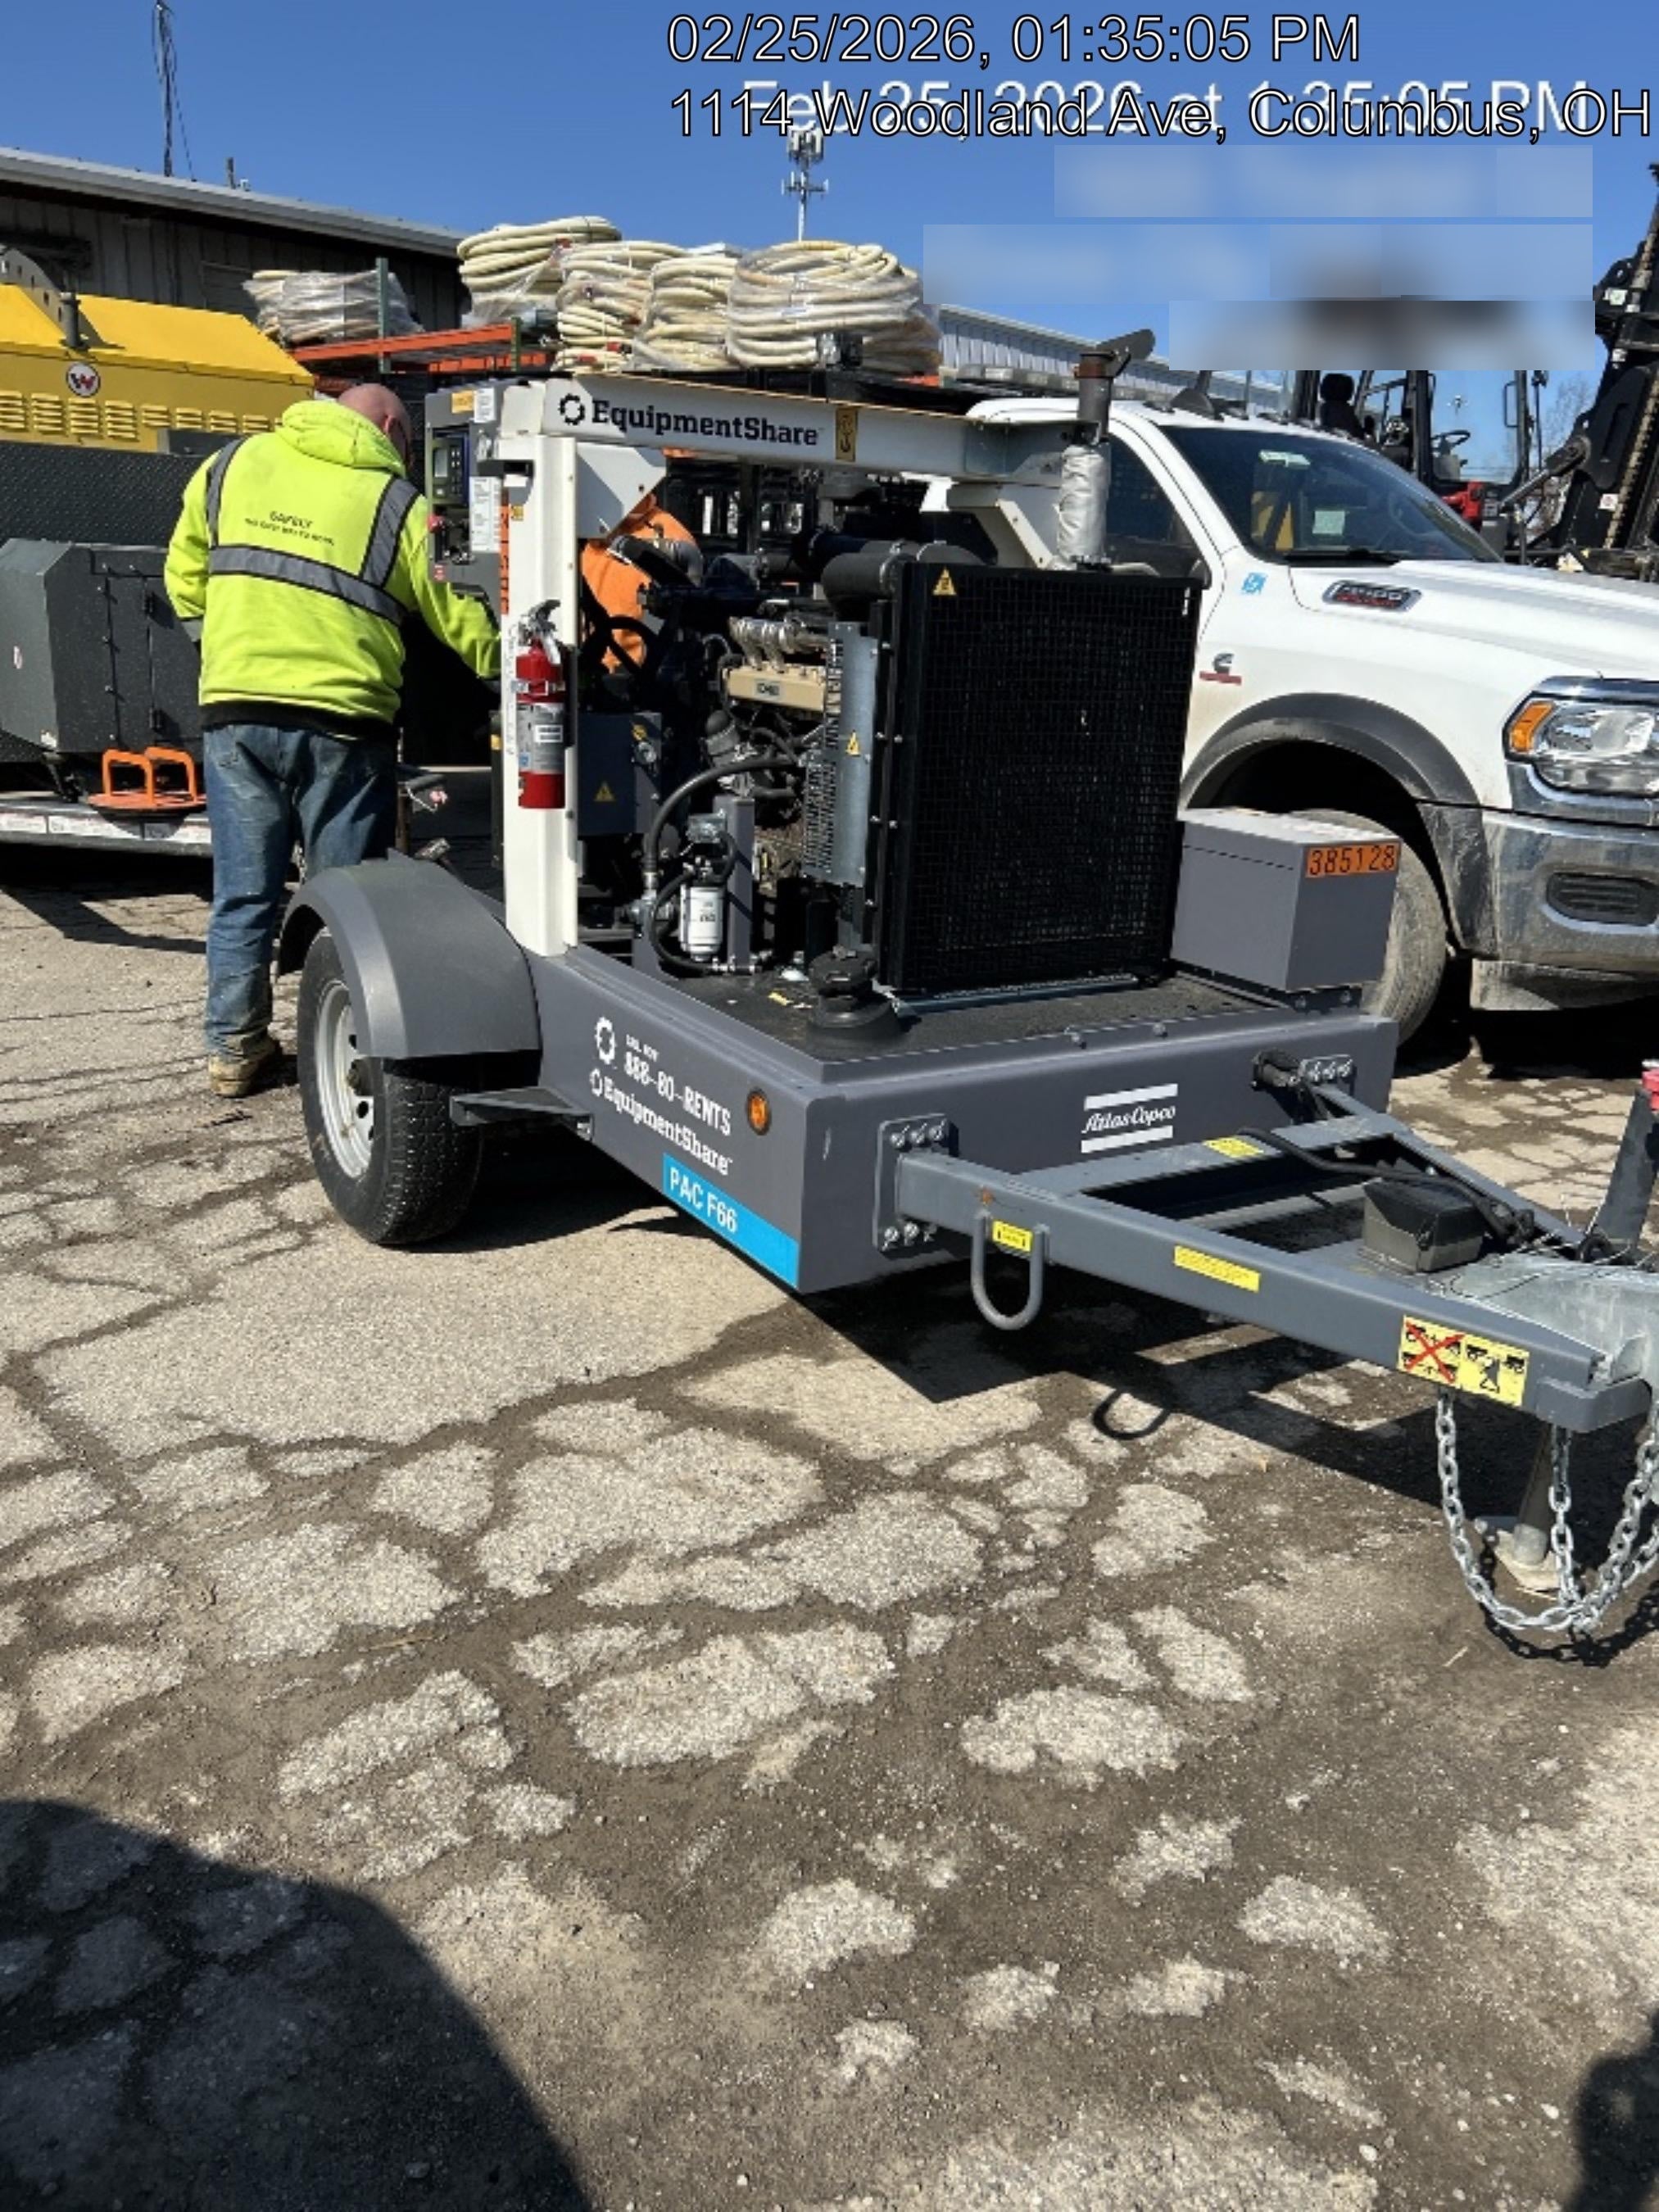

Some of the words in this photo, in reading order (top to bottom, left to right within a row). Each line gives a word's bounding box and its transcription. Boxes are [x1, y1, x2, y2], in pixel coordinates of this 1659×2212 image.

[591, 399, 818, 446] EquipmentShare
[1310, 844, 1394, 876] 385128
[604, 1076, 729, 1176] EquipmentShare
[670, 1167, 704, 1209] PAC
[707, 1194, 737, 1233] F66
